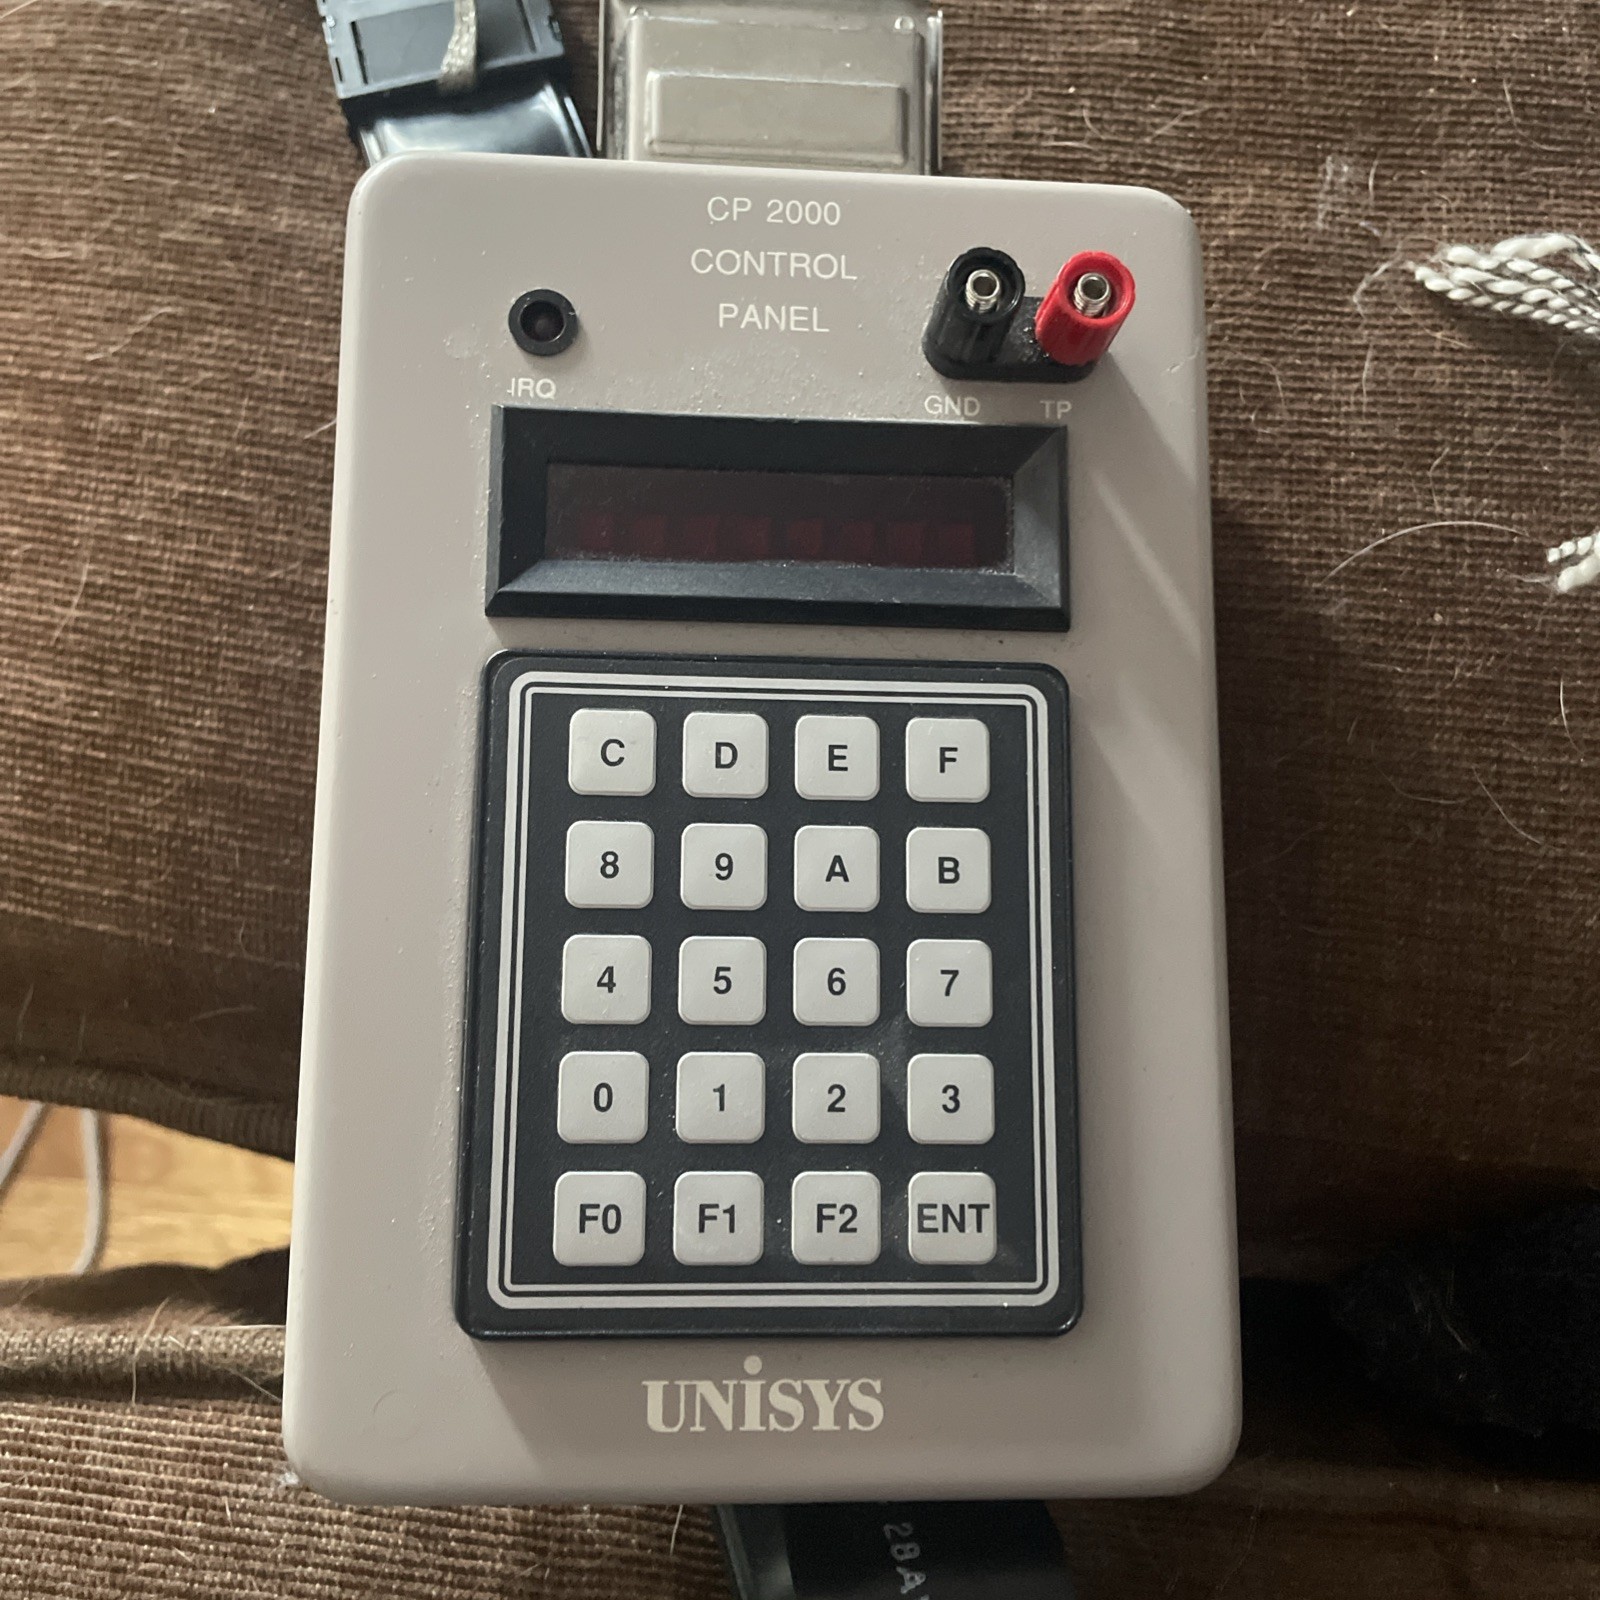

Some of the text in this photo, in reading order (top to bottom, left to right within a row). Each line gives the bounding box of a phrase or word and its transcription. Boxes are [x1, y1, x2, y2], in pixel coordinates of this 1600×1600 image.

[706, 195, 842, 226] CP 2000
[690, 248, 858, 281] CONTROL
[718, 303, 830, 333] PANEL
[510, 377, 557, 400] IRQ
[924, 395, 980, 417] GND
[1040, 400, 1073, 420] TP
[600, 738, 625, 767] C
[715, 741, 738, 769] D
[828, 744, 849, 772] E
[939, 746, 959, 774] F
[600, 850, 620, 879] 8
[715, 852, 734, 881] 9
[825, 854, 850, 883] A
[938, 856, 960, 885] B
[596, 965, 617, 994] 4
[713, 966, 732, 995] 5
[827, 967, 847, 996] 6
[940, 969, 960, 997] 7
[593, 1082, 614, 1113] 0
[712, 1083, 725, 1112] 1
[827, 1083, 846, 1113] 2
[941, 1084, 961, 1114] 3
[579, 1203, 622, 1235] F0
[698, 1203, 736, 1234] F1
[816, 1203, 858, 1234] F2
[917, 1203, 991, 1234] ENT
